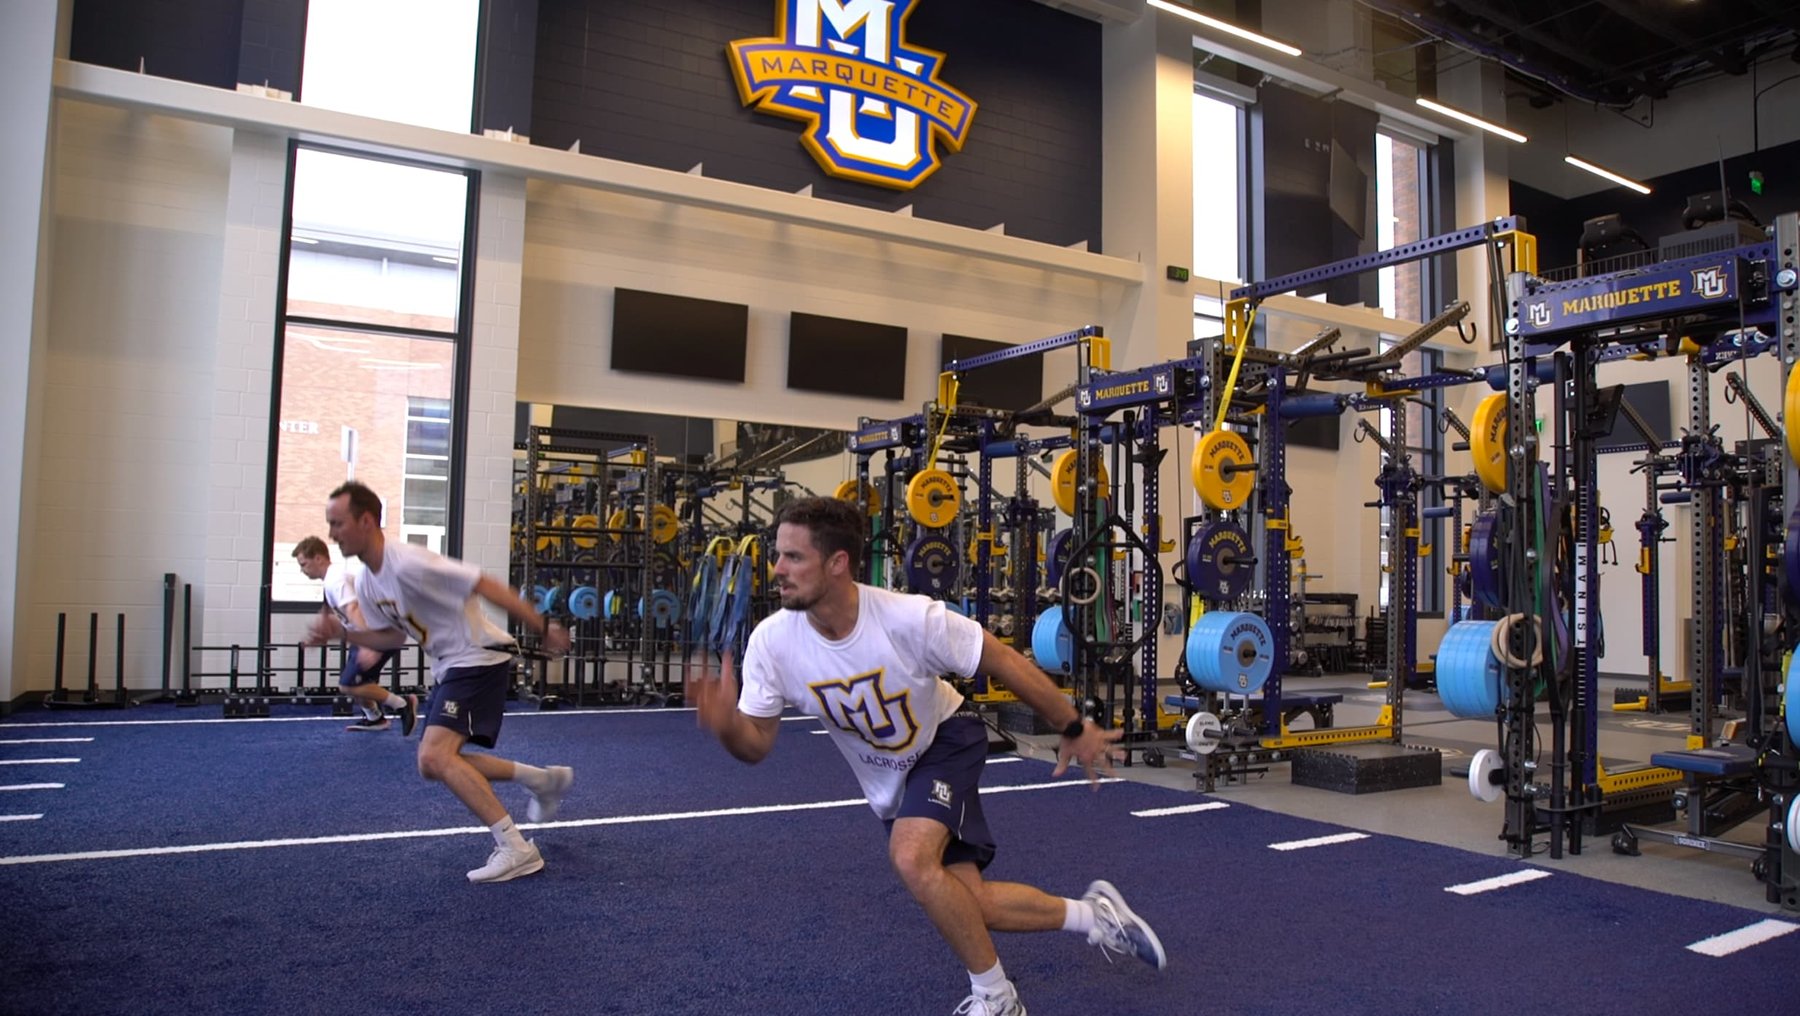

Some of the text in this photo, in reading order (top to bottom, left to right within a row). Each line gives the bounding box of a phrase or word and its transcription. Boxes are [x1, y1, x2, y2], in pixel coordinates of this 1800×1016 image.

[761, 56, 954, 119] MARQUETTE
[1529, 269, 1727, 326] MU MARQUETTE MU
[1095, 380, 1150, 400] MARQUETTE
[1577, 544, 1587, 647] TSUNAMI
[811, 670, 918, 750] MU
[935, 782, 950, 801] MU
